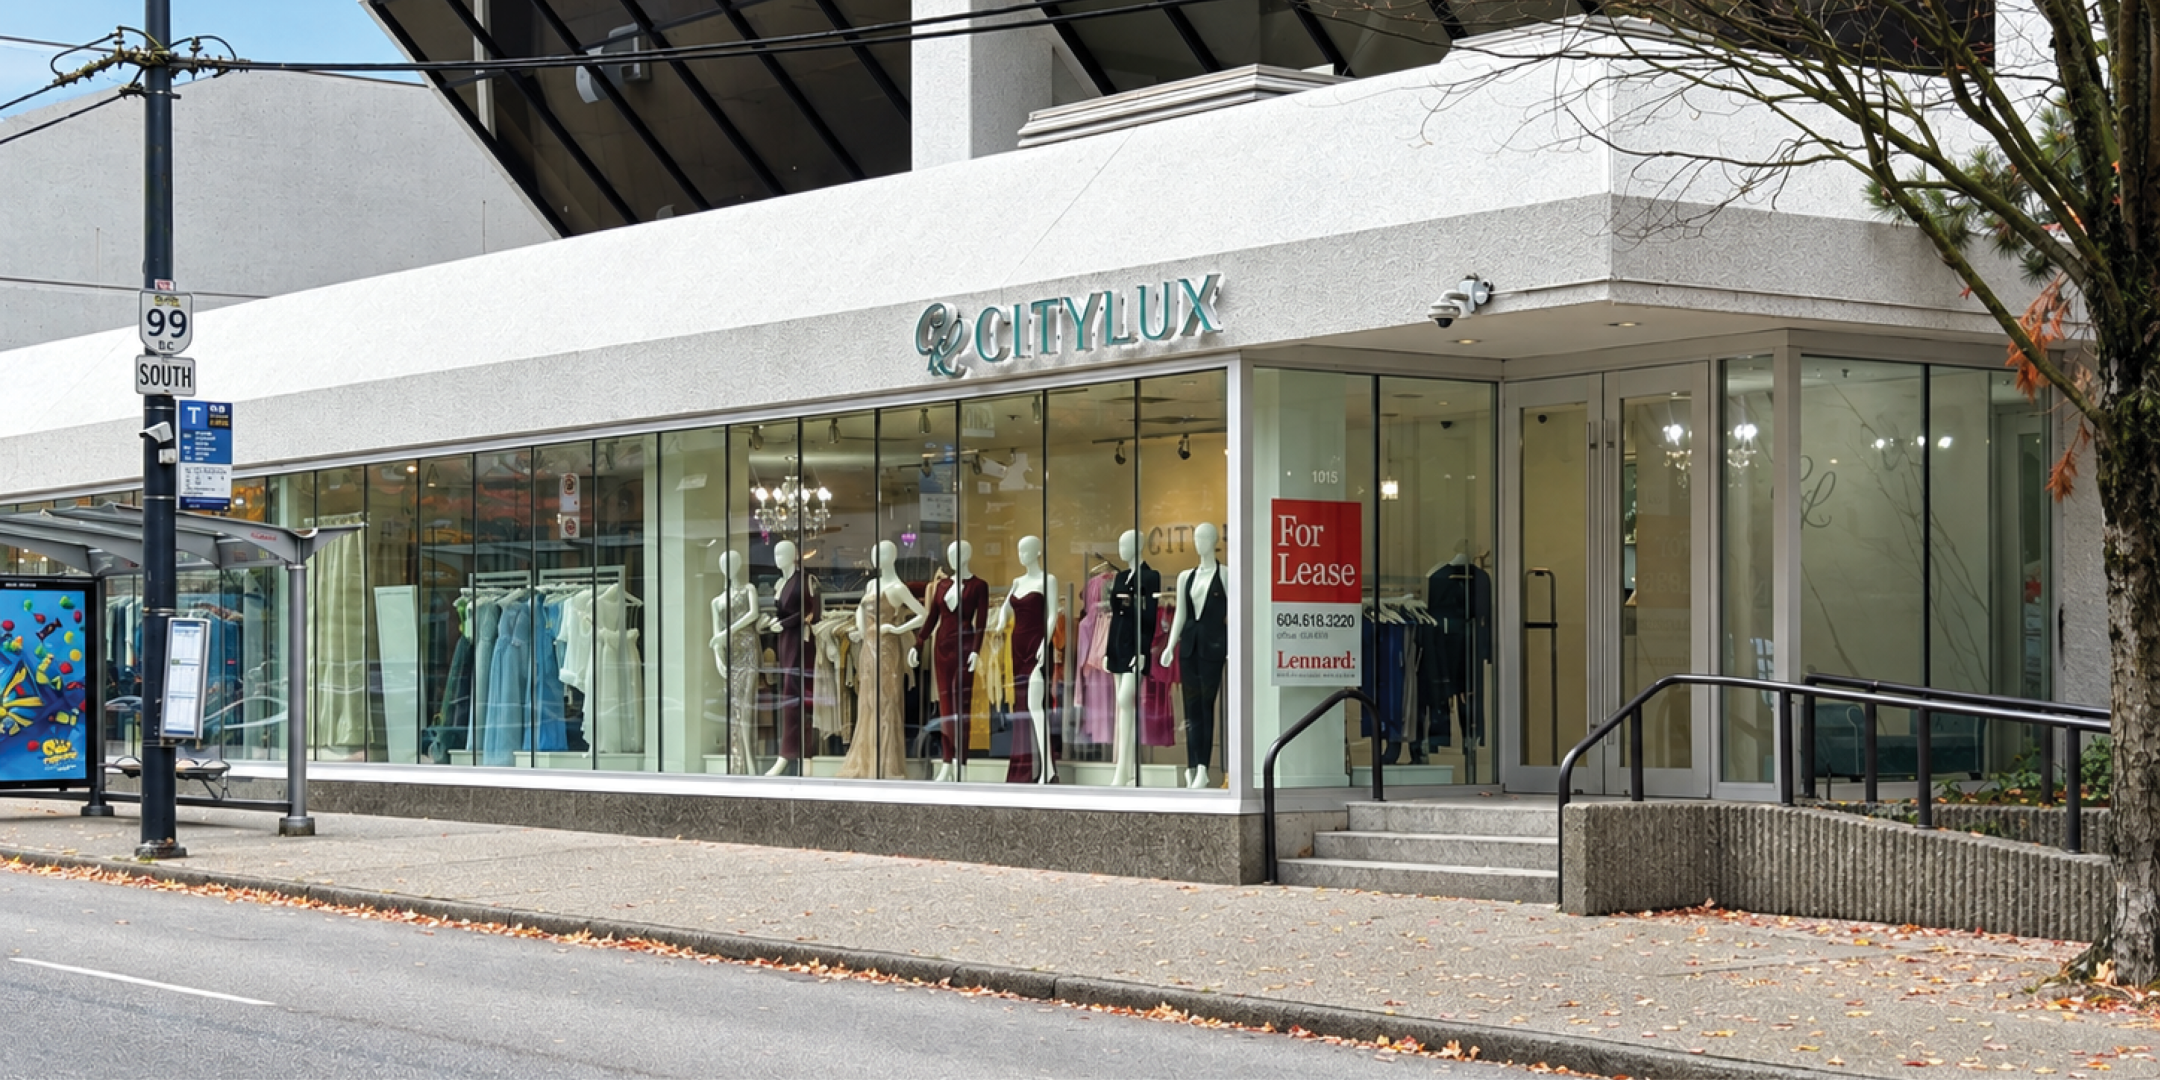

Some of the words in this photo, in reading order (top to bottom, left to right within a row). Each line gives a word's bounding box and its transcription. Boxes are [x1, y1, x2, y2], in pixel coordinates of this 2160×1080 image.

[147, 308, 187, 338] 99
[975, 273, 1225, 364] CITYLUX
[139, 363, 192, 388] SOUTH
[187, 406, 201, 424] T
[1312, 470, 1338, 484] 1015
[1277, 515, 1323, 547] For
[1277, 553, 1355, 586] Lease
[1277, 650, 1355, 669] Lennard:
